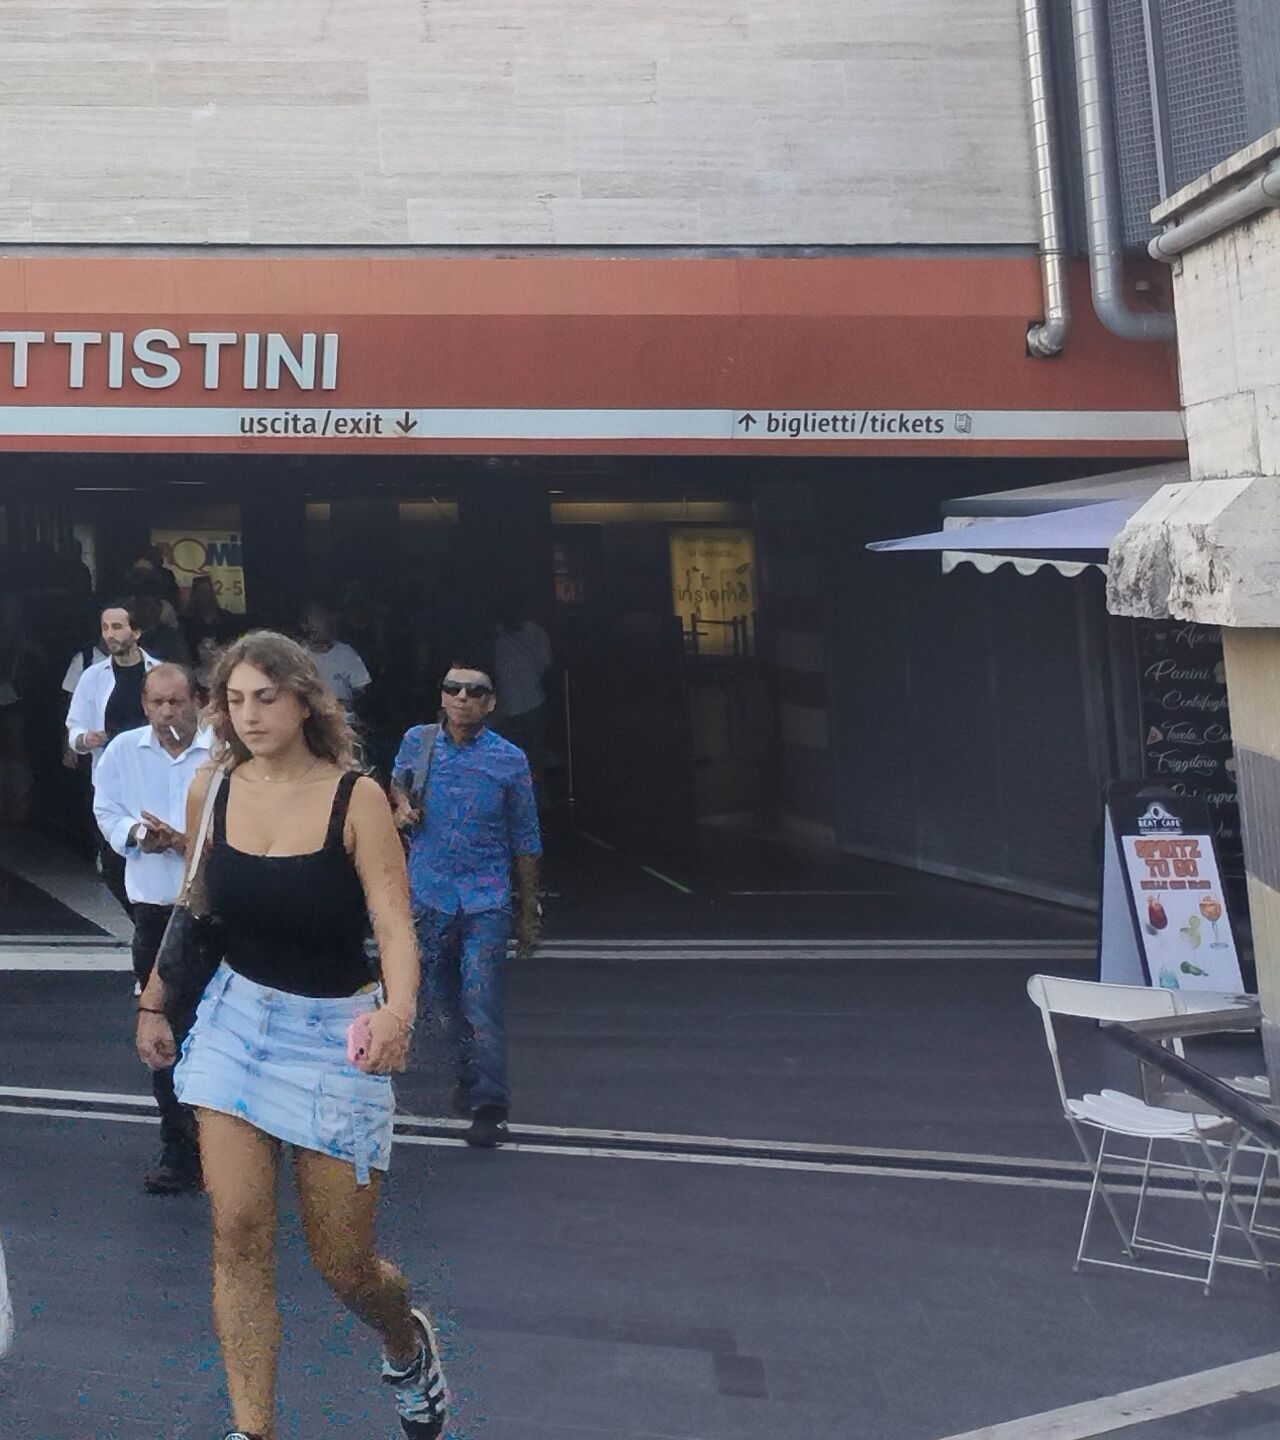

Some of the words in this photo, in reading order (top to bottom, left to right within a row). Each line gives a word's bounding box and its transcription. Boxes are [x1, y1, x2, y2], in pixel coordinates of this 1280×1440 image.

[240, 410, 383, 436] uscita/exit
[766, 412, 945, 438] biglietti/tickets
[1144, 658, 1211, 682] Panini
